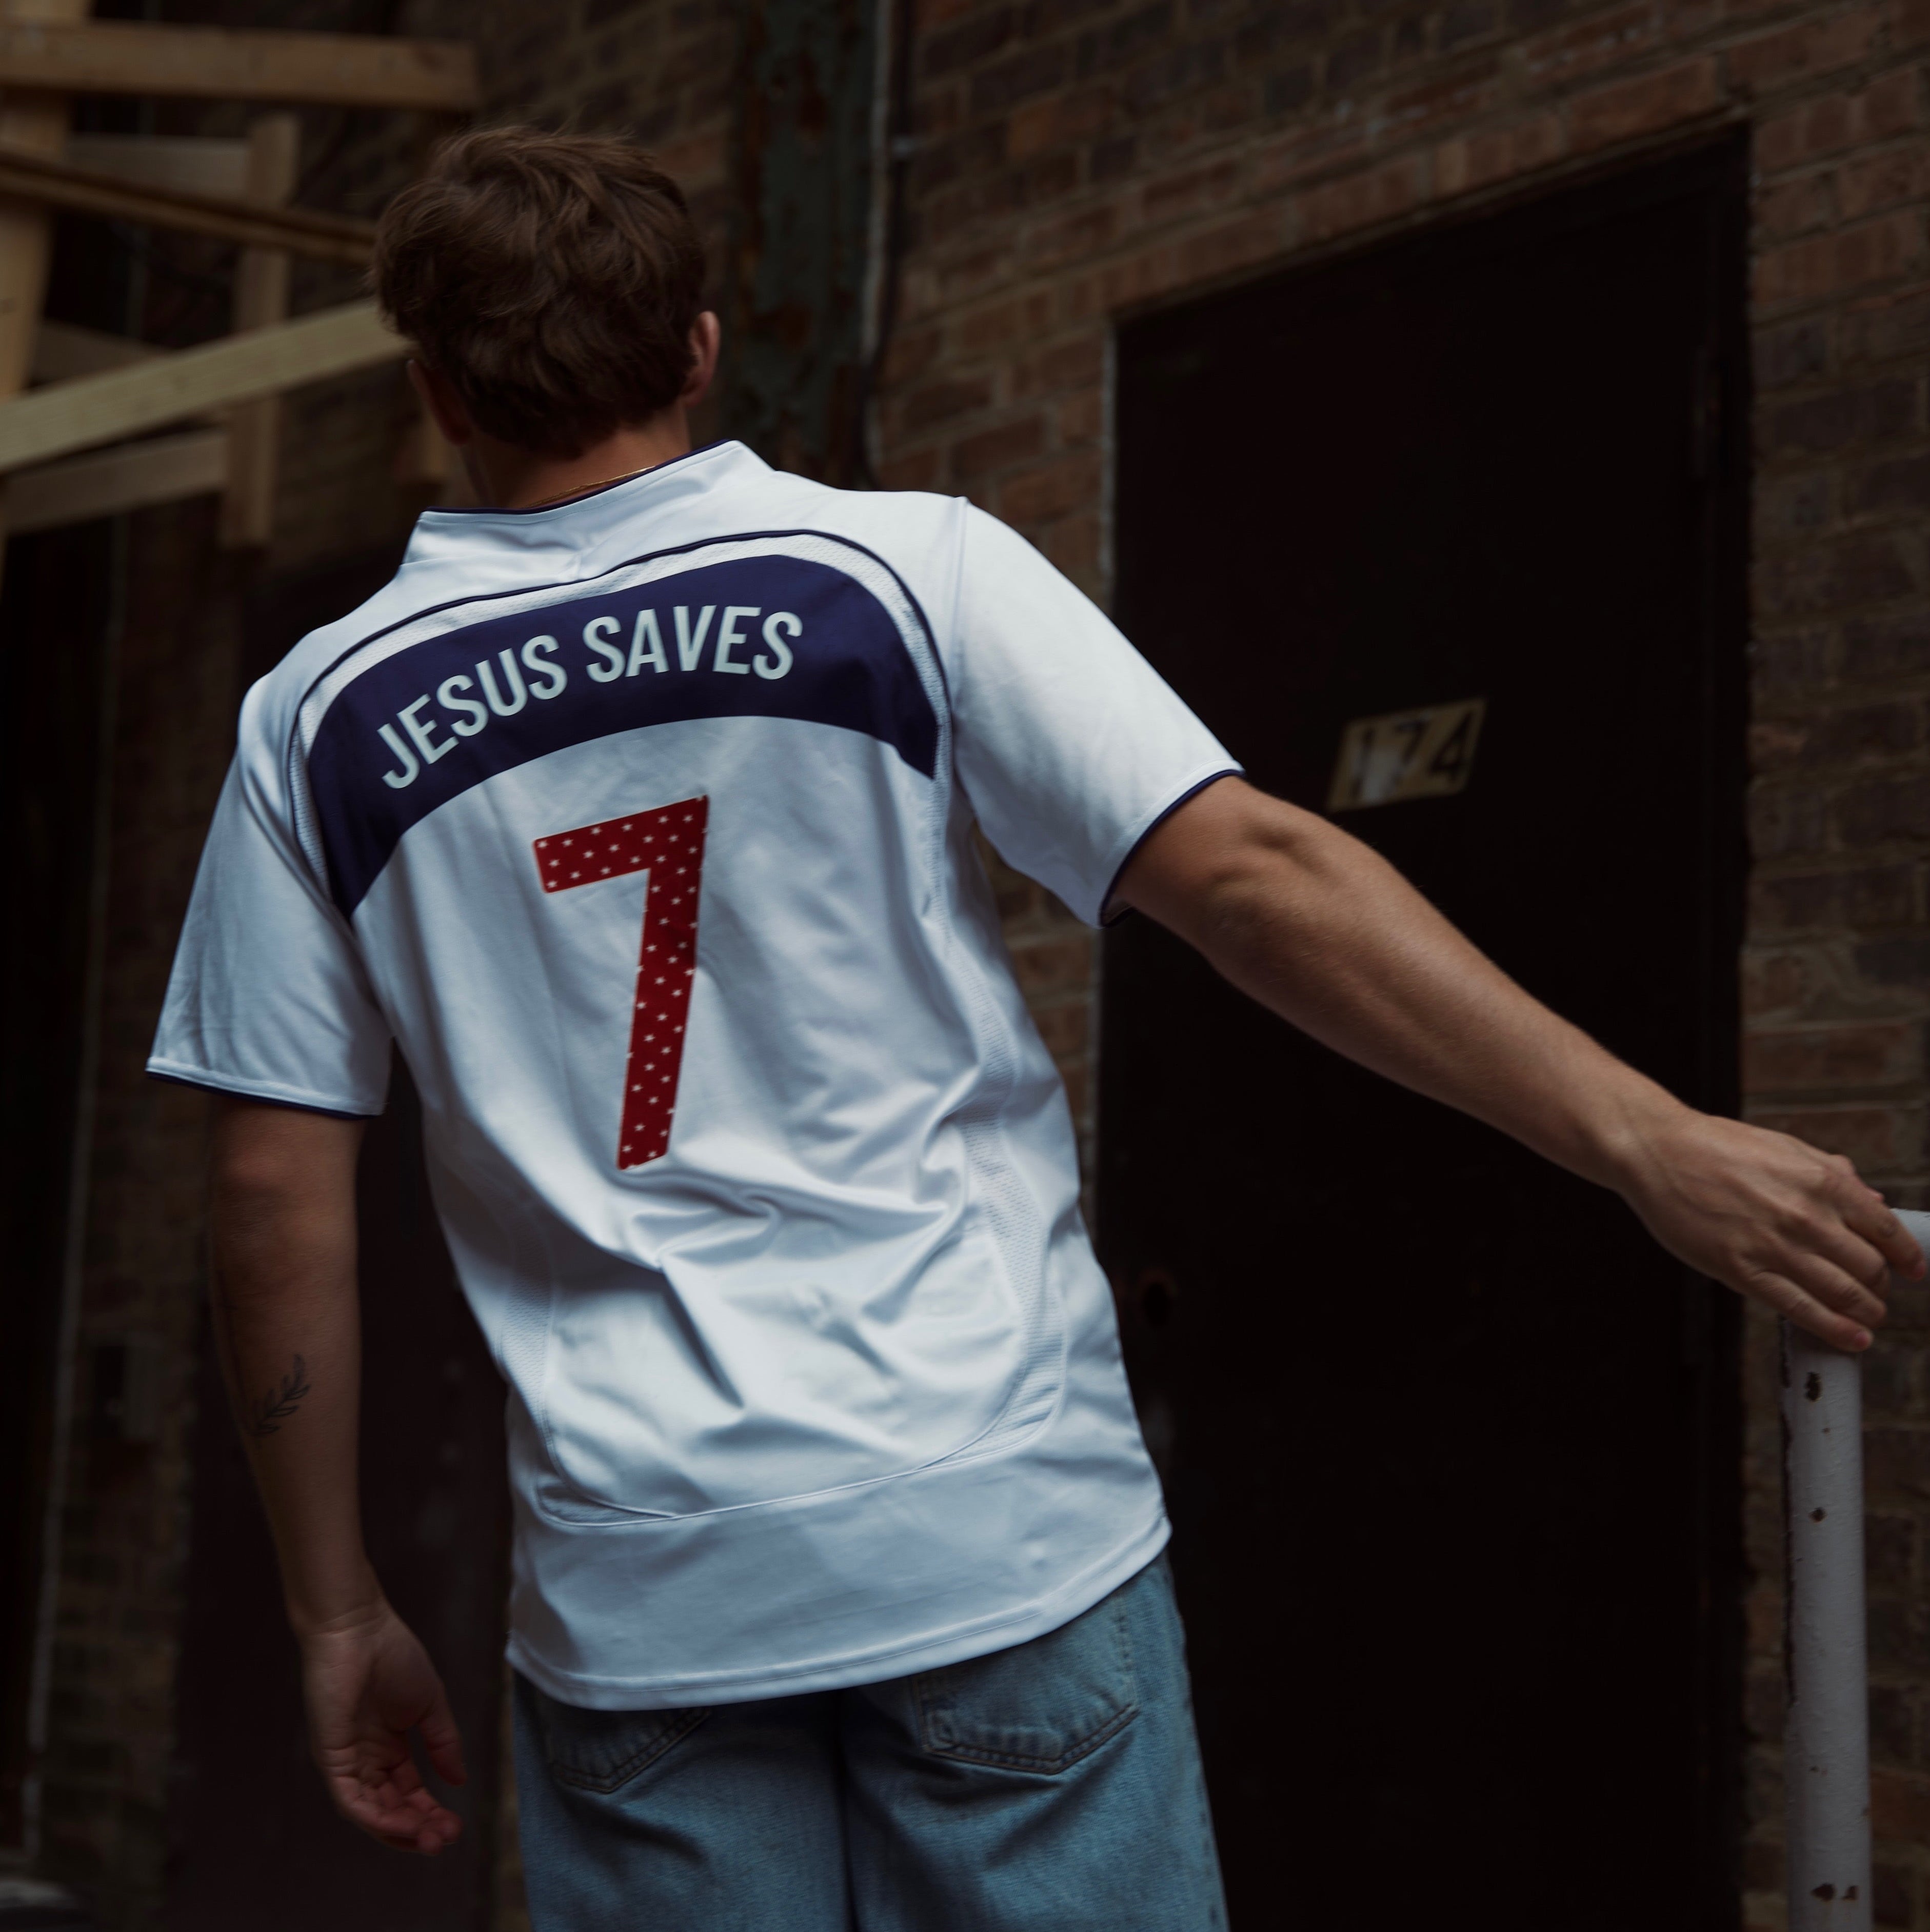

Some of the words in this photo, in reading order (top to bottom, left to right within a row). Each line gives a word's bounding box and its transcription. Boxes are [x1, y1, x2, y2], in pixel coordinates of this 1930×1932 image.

[376, 634, 568, 789] JESUS
[582, 605, 803, 683] SAVES
[533, 794, 710, 1171] 7
